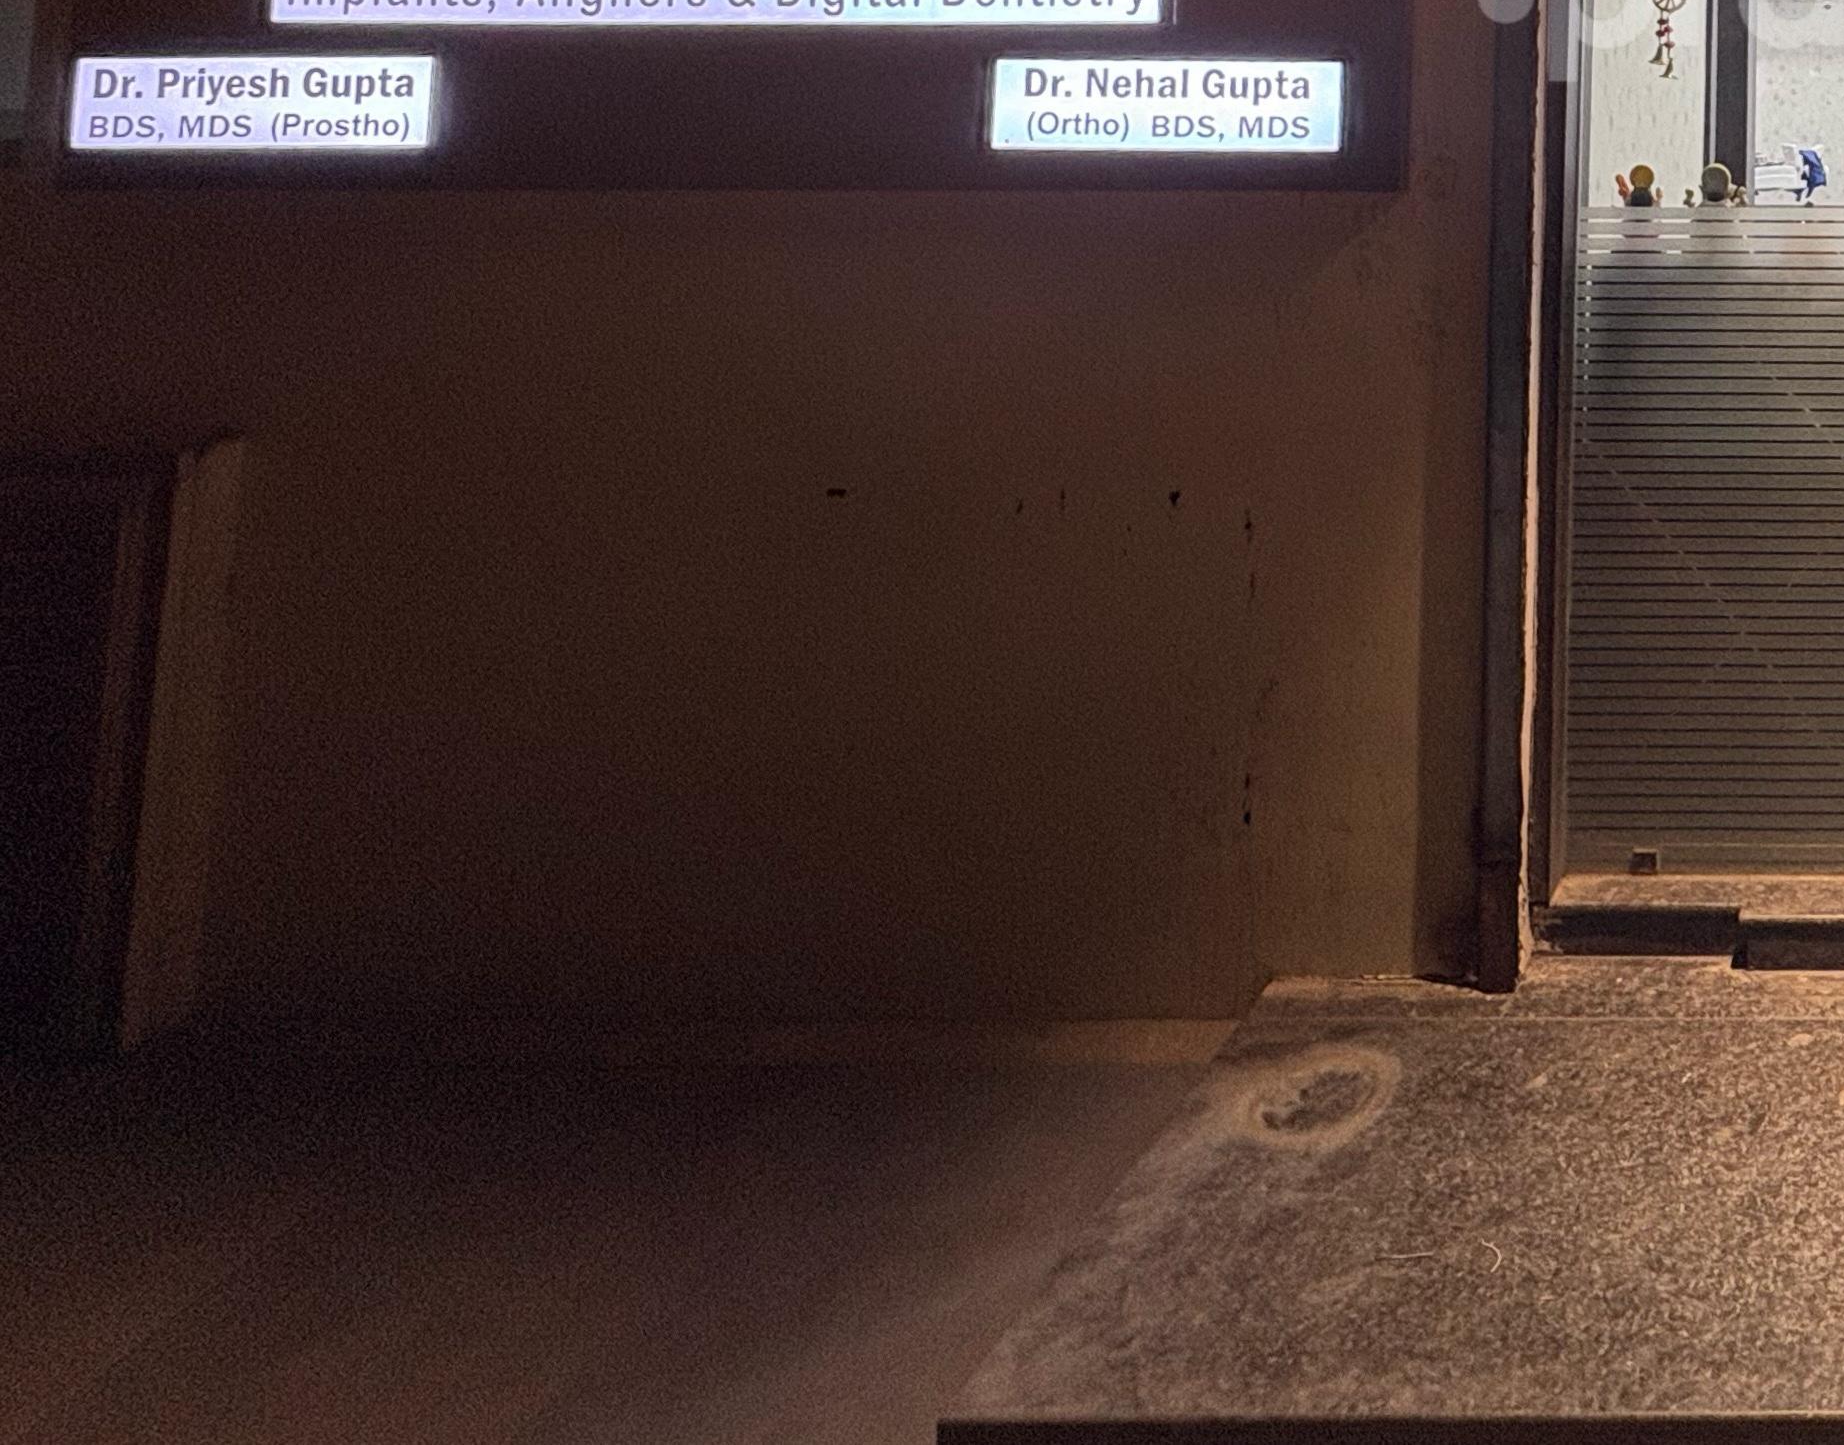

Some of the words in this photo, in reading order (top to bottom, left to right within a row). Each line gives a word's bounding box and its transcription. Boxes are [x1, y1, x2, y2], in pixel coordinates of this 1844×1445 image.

[93, 68, 143, 99] Dr.
[157, 67, 289, 105] Priyesh
[303, 67, 414, 105] Gupta
[1024, 68, 1072, 97] Dr.
[1086, 68, 1189, 99] Nehal
[1202, 68, 1310, 106] Gupta
[88, 115, 164, 142] BDS,
[178, 115, 252, 138] MDS
[271, 112, 410, 142] (Prostho)
[1027, 111, 1130, 142] (Ortho)
[1151, 115, 1225, 143] BDS,
[1238, 116, 1311, 139] MDS
